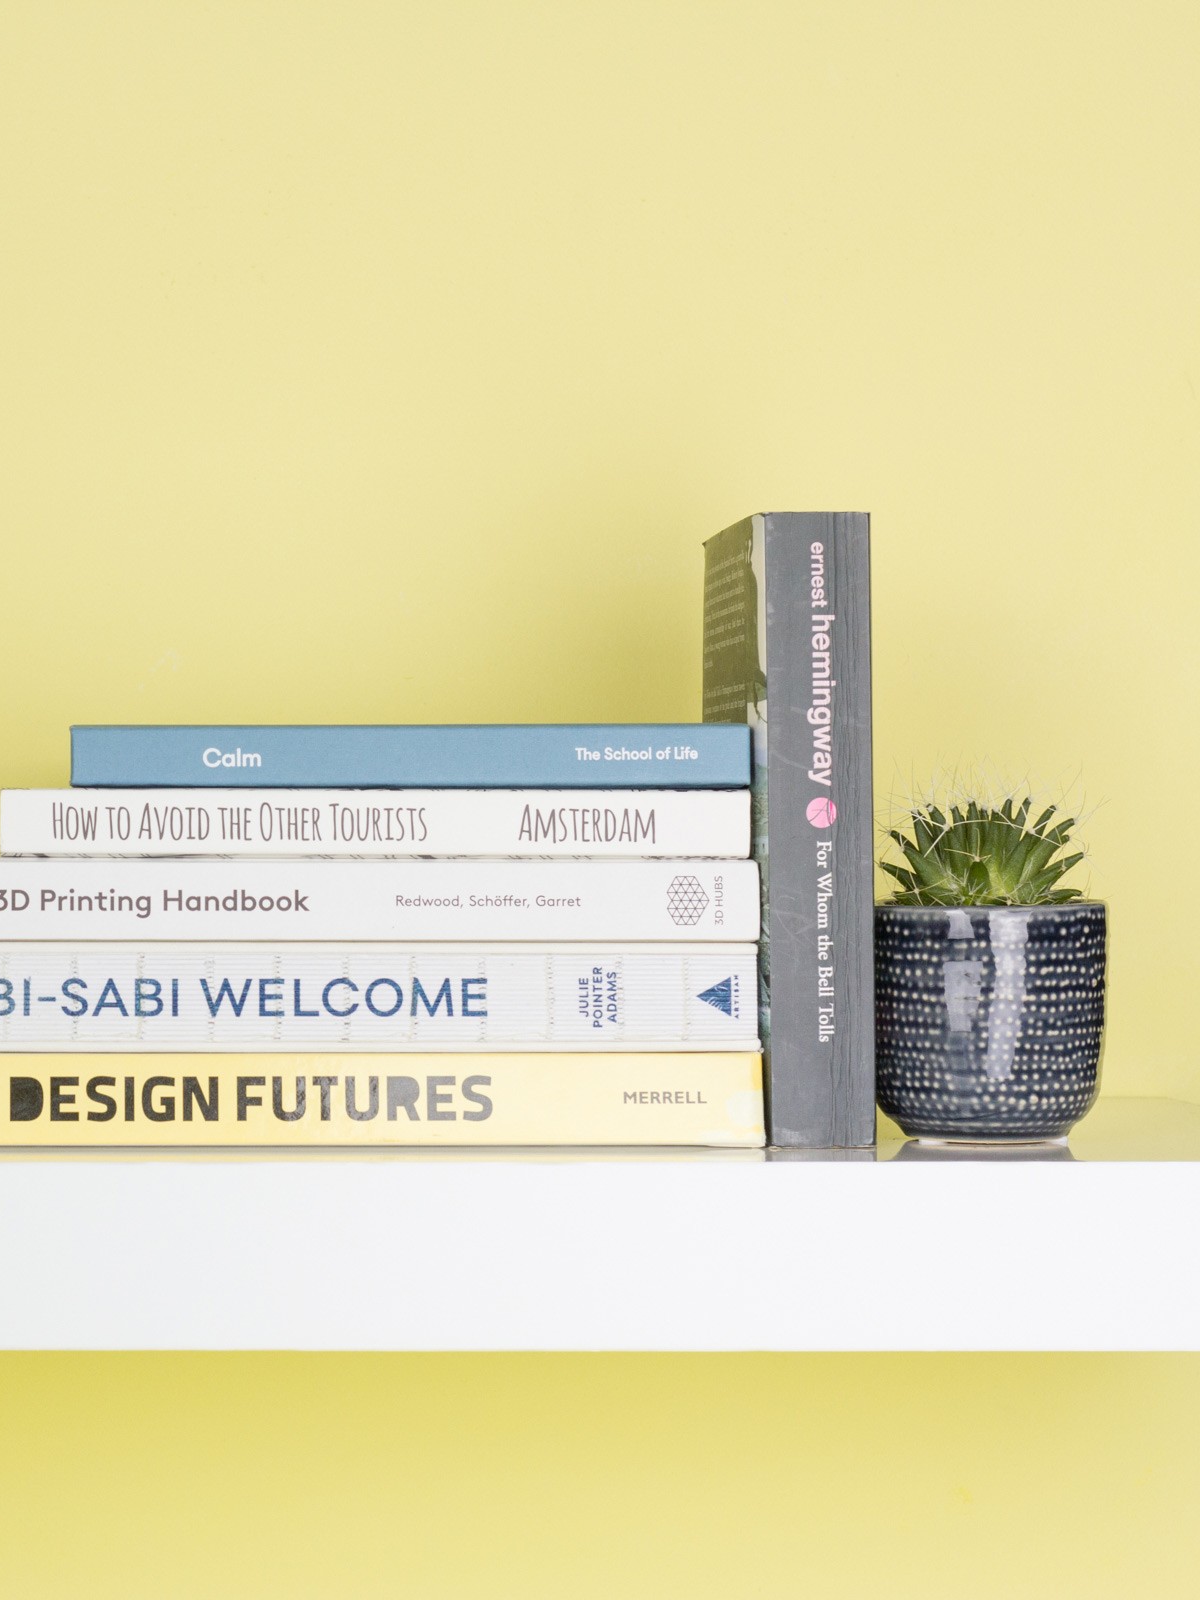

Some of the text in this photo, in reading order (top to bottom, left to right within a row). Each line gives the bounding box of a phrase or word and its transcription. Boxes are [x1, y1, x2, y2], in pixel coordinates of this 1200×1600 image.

[806, 541, 837, 787] ernest hemingway
[202, 747, 262, 768] Calm
[575, 746, 699, 761] The School of Life
[40, 889, 152, 919] Printing
[163, 889, 310, 912] Handbook
[395, 893, 581, 911] Redwood, Schöffer, Garret
[714, 875, 724, 926] 3D HUBS
[816, 840, 836, 1043] For Whom the Bell Tolls
[199, 977, 489, 1017] WELCOME
[578, 977, 590, 1018] JULIE
[592, 966, 603, 1028] POINTER
[606, 971, 618, 1024] ADAMS
[9, 1075, 492, 1122] DESIGN FUTURES
[623, 1091, 708, 1105] MERRELL
